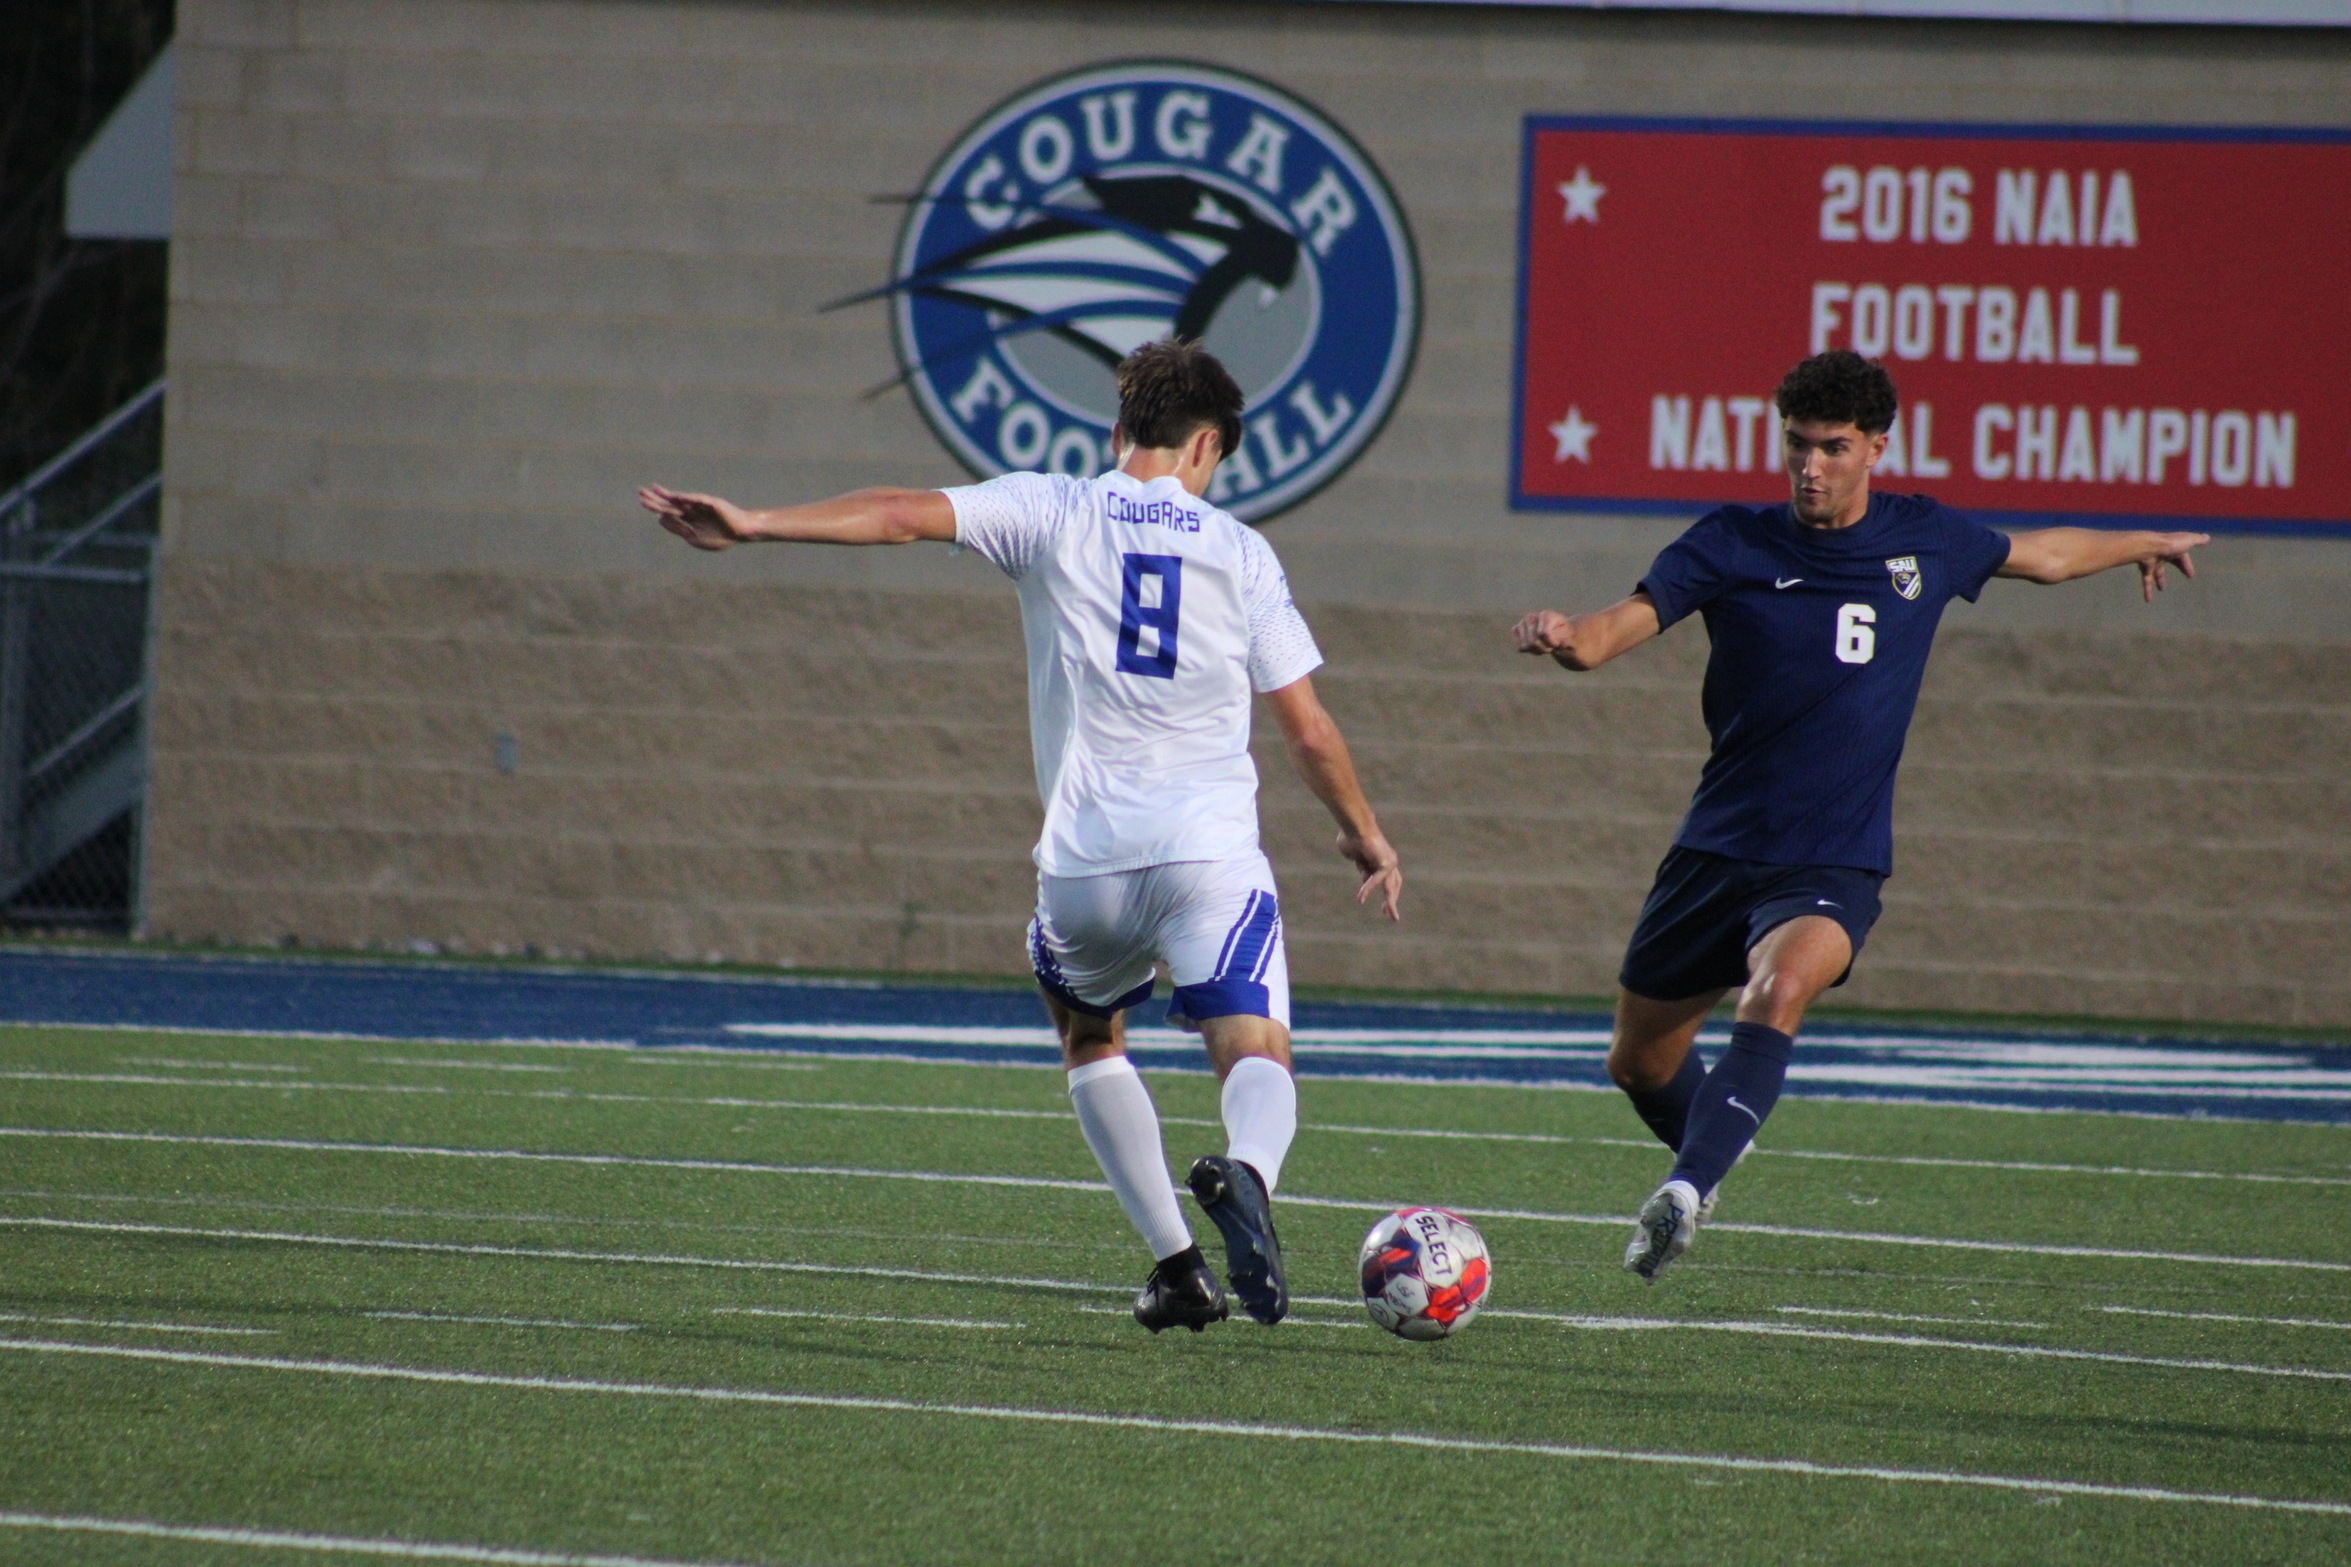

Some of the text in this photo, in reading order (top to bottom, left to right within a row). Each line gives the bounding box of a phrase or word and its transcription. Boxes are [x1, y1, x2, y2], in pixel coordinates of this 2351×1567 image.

[965, 91, 1356, 256] COUGAR
[1819, 164, 2139, 249] 2016 NAIA
[1810, 281, 2141, 367] FOOTBALL
[953, 358, 1350, 497] FOOALL
[1650, 394, 2298, 489] NATIAL CHAMPION
[1107, 491, 1201, 533] COUGARS
[1888, 559, 1915, 573] SAU
[1115, 552, 1183, 681] 8
[1834, 602, 1878, 665] 6
[1415, 1215, 1453, 1276] SELECT
